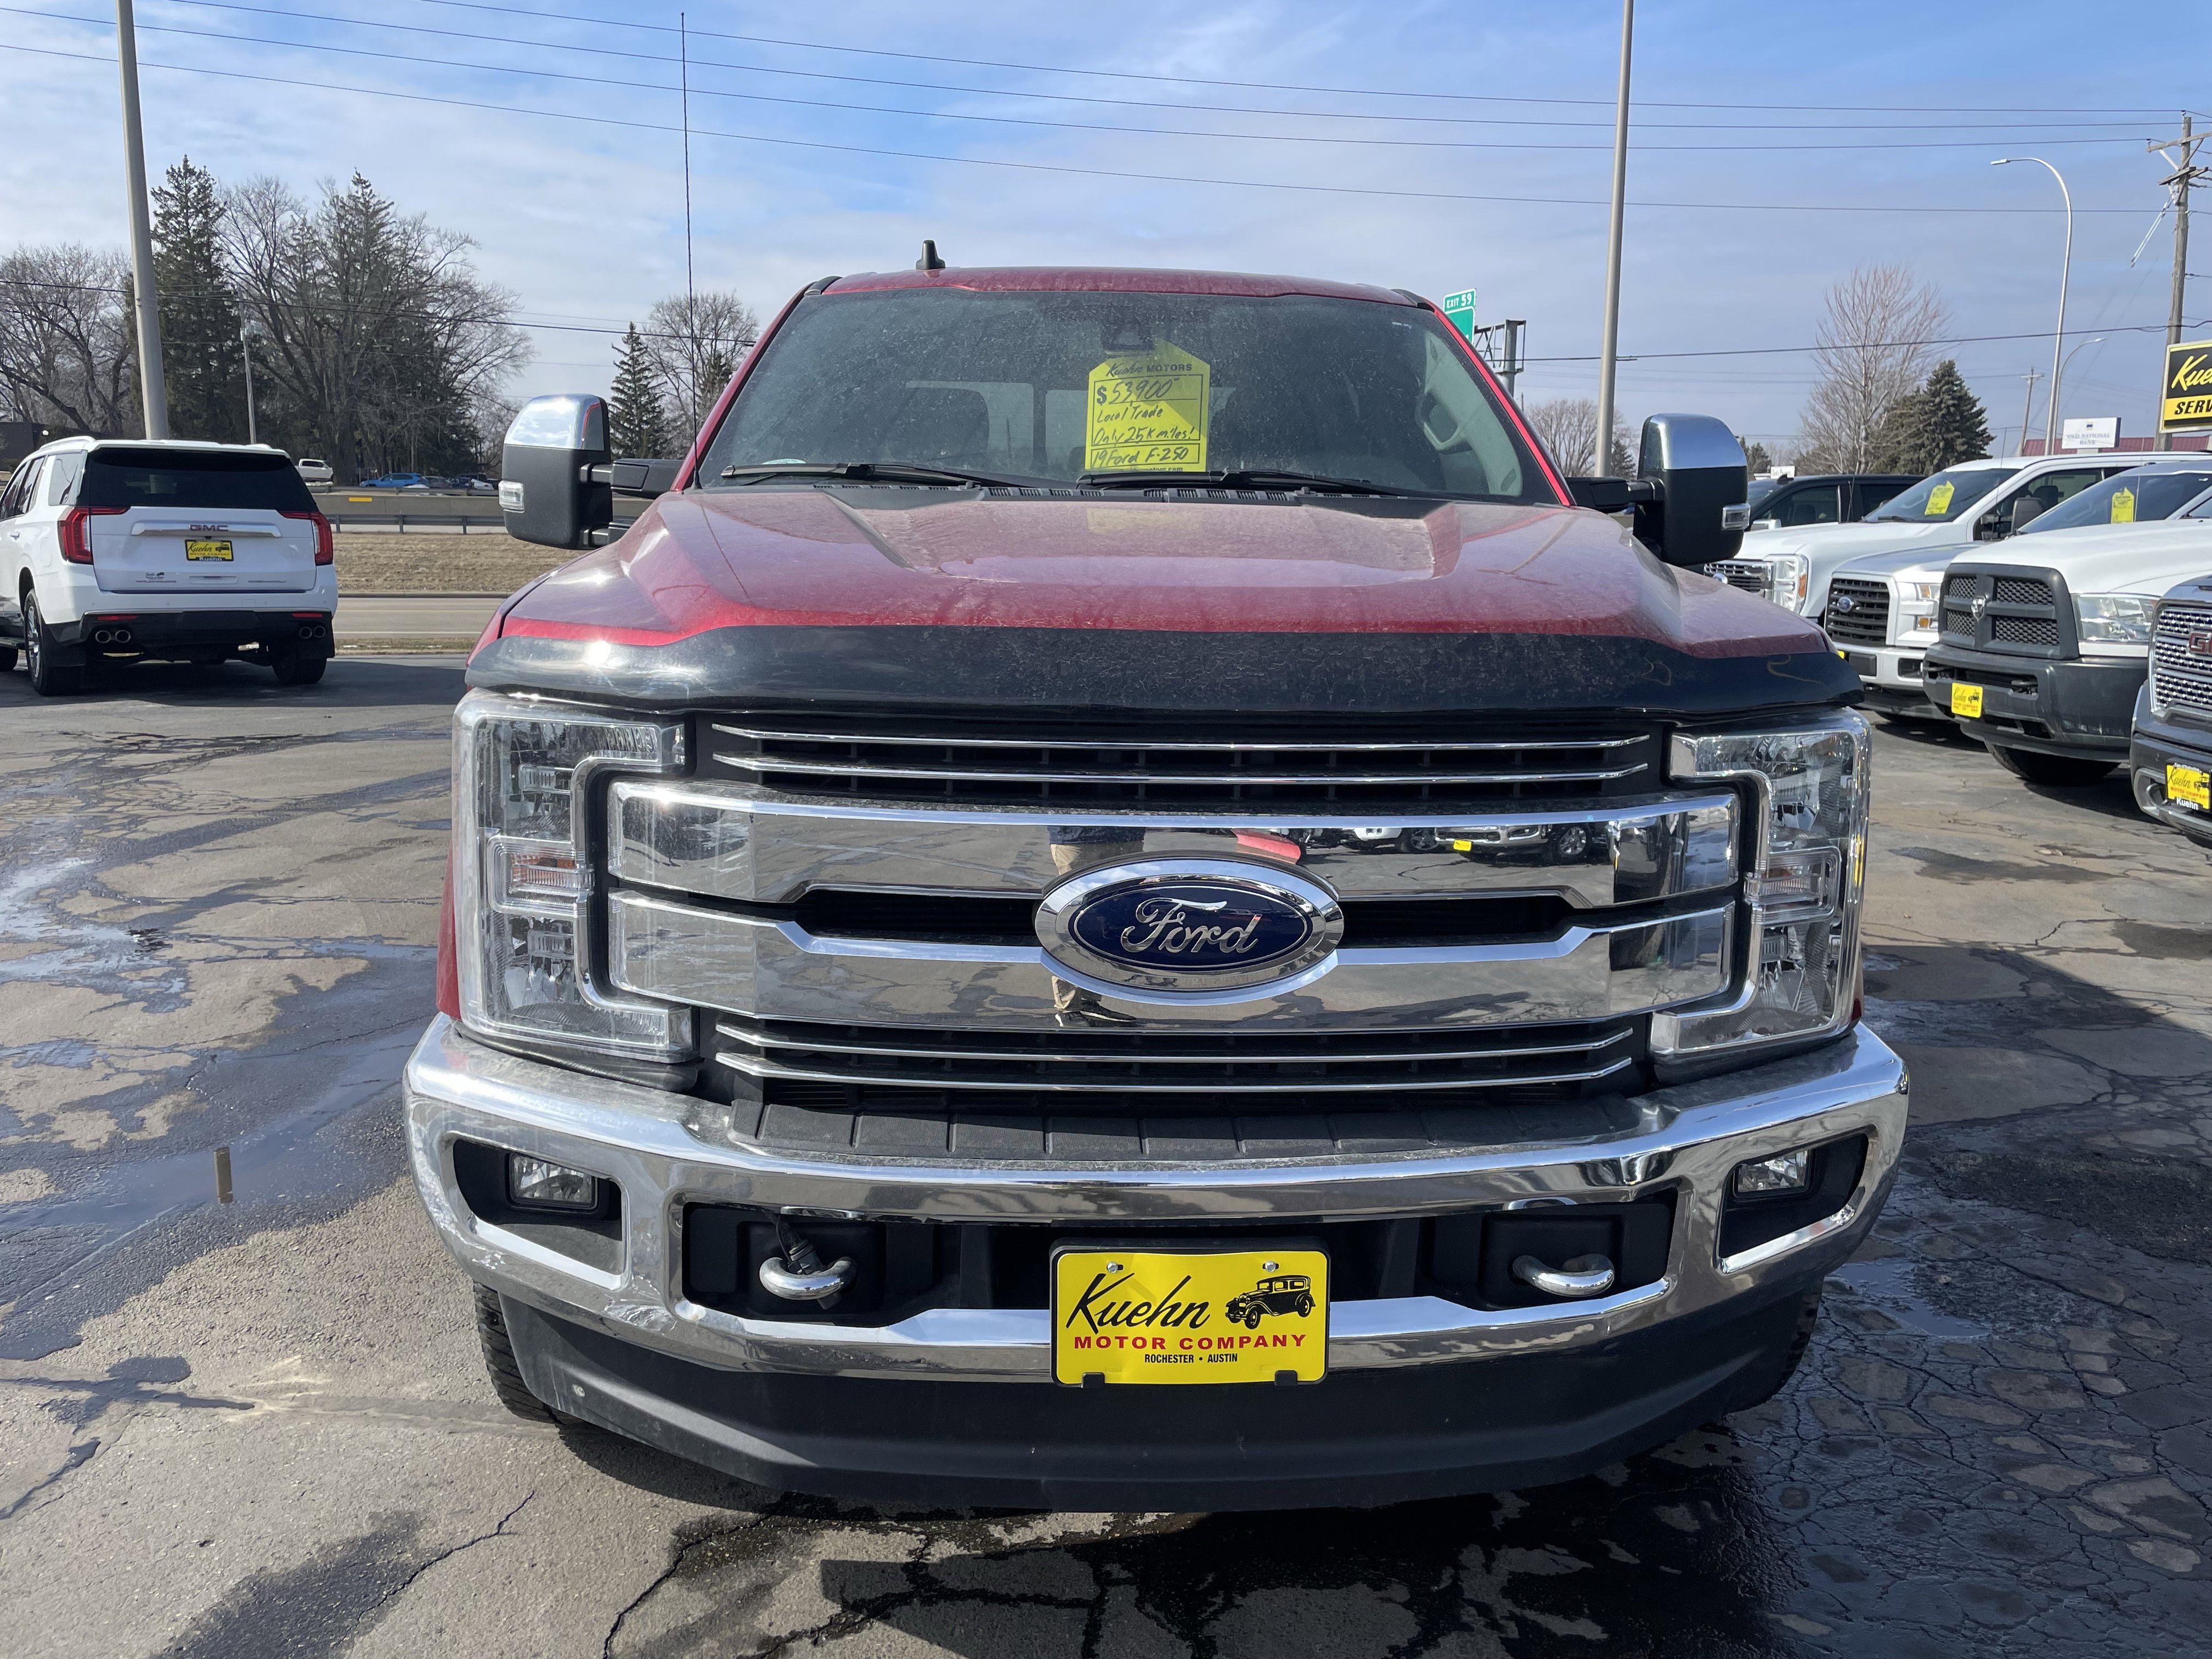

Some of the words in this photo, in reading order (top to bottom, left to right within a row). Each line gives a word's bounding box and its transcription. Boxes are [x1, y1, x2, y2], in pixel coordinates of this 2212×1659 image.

[1446, 298, 1459, 309] EXIT
[1461, 293, 1472, 307] 59
[1147, 363, 1192, 373] MOTORS
[1097, 407, 1128, 423] Local
[1131, 404, 1163, 420] Trade
[1093, 427, 1124, 447] Only
[1145, 446, 1189, 463] F-250
[188, 543, 213, 552] Kuehn
[2168, 768, 2191, 789] Kuehn
[2176, 797, 2199, 811] Kuehn
[1121, 897, 1263, 953] Ford
[1066, 1272, 1210, 1335] Kuehn
[1074, 1336, 1166, 1350] MOTOR
[1179, 1334, 1307, 1350] COMPANY
[1144, 1354, 1194, 1364] ROCHESTER
[1207, 1353, 1238, 1363] AUSTIN
